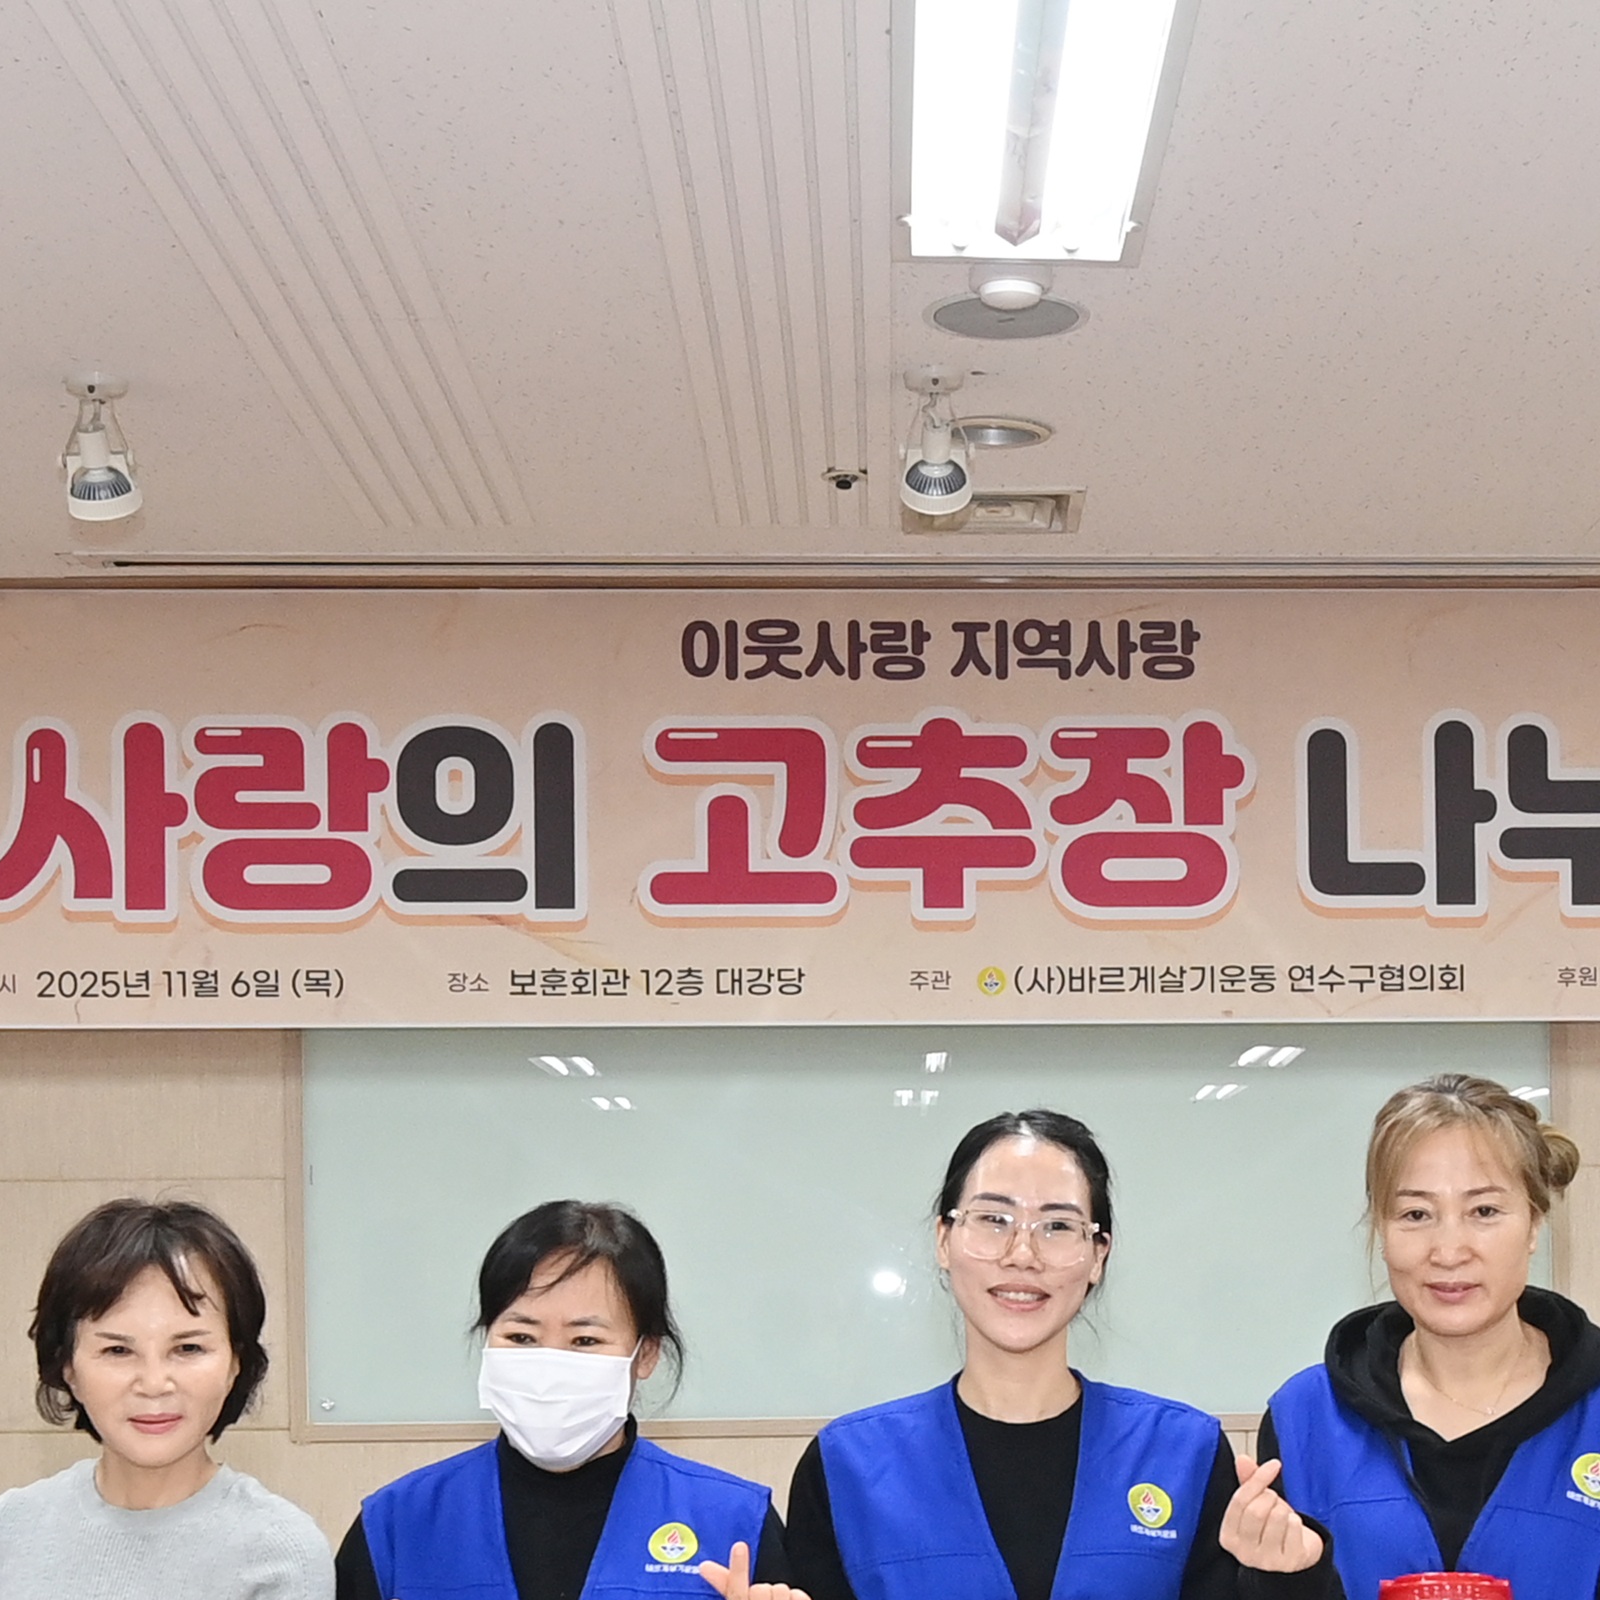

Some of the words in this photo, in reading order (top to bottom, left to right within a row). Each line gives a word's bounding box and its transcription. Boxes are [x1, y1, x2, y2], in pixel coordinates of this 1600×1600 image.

[681, 618, 932, 681] 이웃사랑
[950, 618, 1201, 681] 지역사랑
[652, 720, 1243, 907] 고추장
[36, 969, 151, 999] 2025년
[161, 969, 220, 998] 11월
[230, 969, 280, 998] 6일
[291, 968, 344, 999] (목)
[447, 972, 490, 993] 장소
[508, 967, 631, 997] 보훈회관
[639, 967, 705, 996] 12층
[715, 967, 806, 996] 대강당
[909, 970, 952, 991] 주관
[1014, 964, 1277, 995] (사)바르게살기운동
[1287, 963, 1465, 994] 연수구협의회
[1557, 966, 1598, 988] 후원
